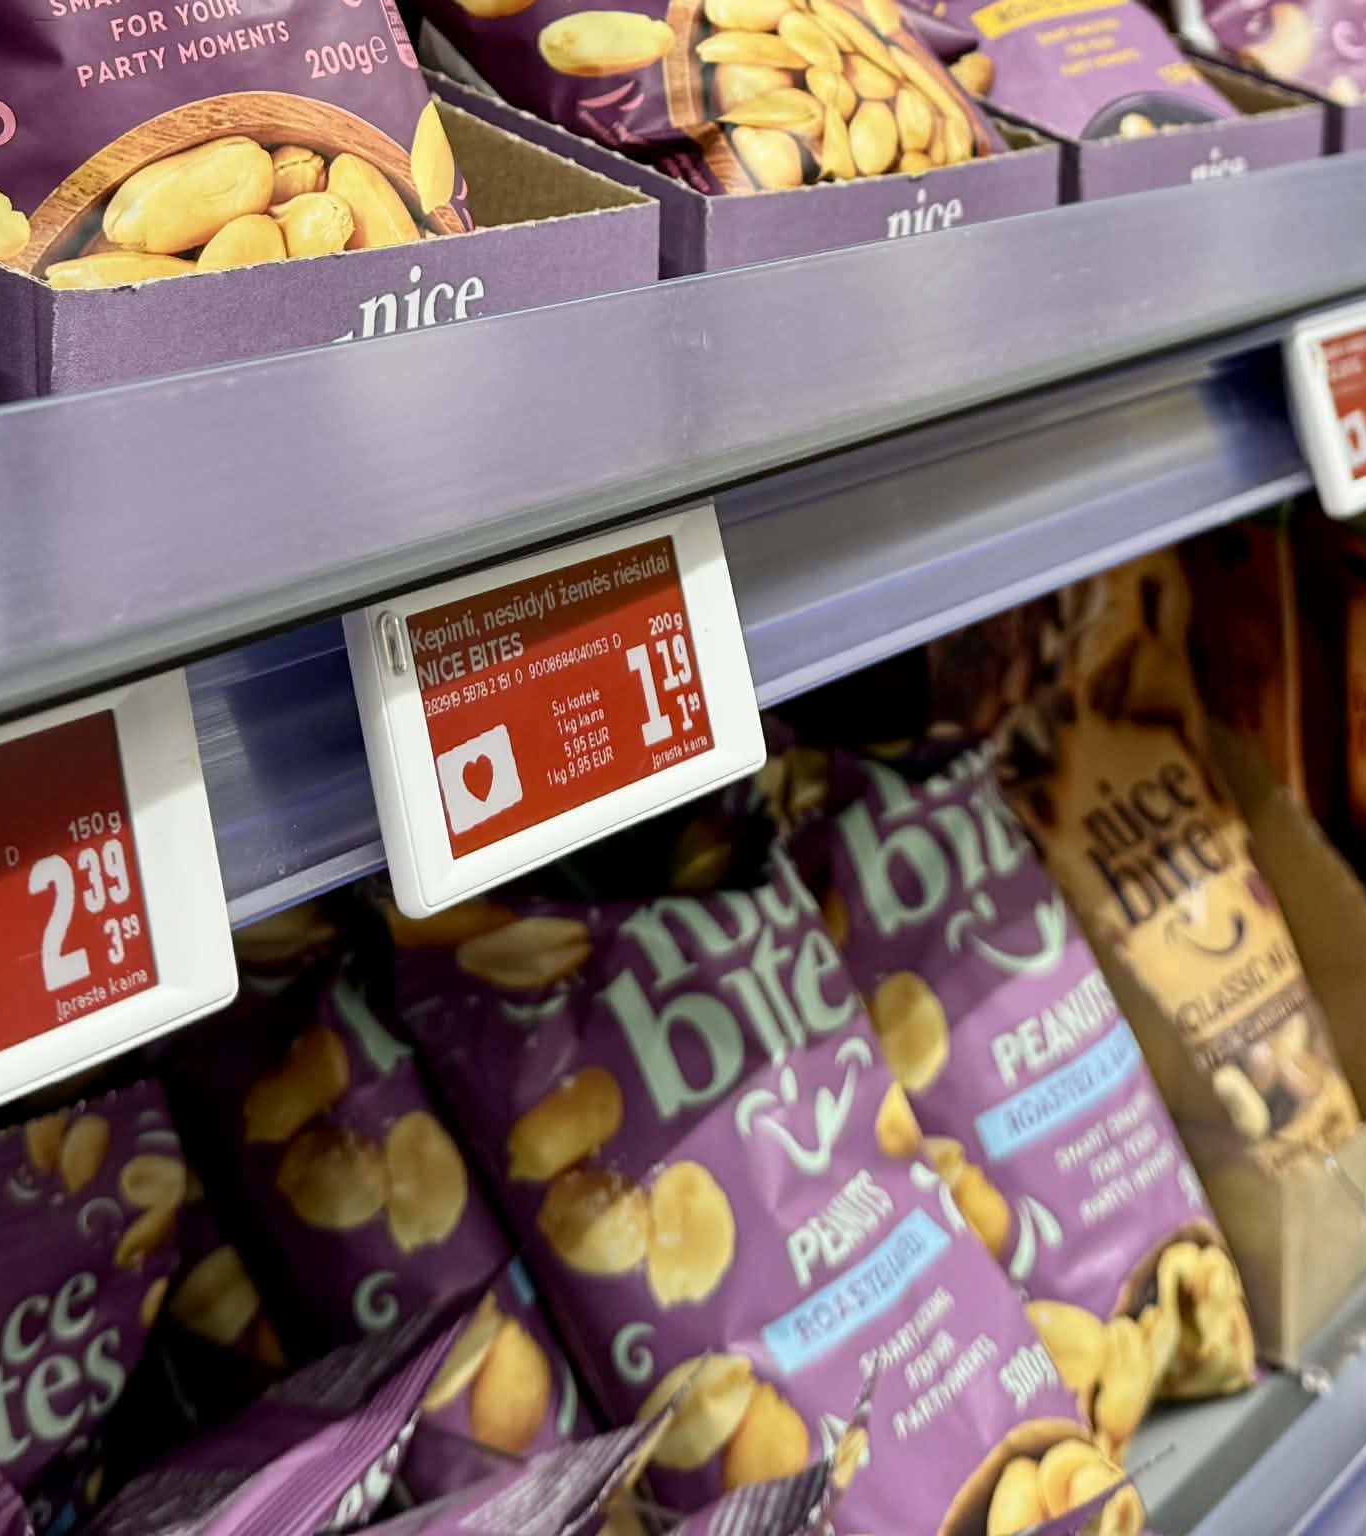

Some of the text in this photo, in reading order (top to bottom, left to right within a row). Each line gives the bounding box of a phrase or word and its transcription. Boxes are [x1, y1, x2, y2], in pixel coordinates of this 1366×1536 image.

[110, 11, 168, 41] FOR
[77, 20, 290, 88] PARTY MOMENTS
[886, 188, 965, 239] nice
[358, 264, 486, 338] nice
[409, 616, 480, 656] Kepinti,
[558, 569, 612, 605] žemės
[613, 547, 671, 589] riešutai
[647, 611, 684, 637] 200 g
[417, 631, 525, 690] NICE BITES
[551, 700, 566, 717] Su
[564, 718, 578, 734] kg
[587, 726, 610, 748] EUR
[554, 765, 567, 785] kg
[592, 745, 614, 770] EUR
[67, 810, 123, 843] 150 g
[110, 969, 149, 996] kaina
[595, 926, 859, 1120] bite
